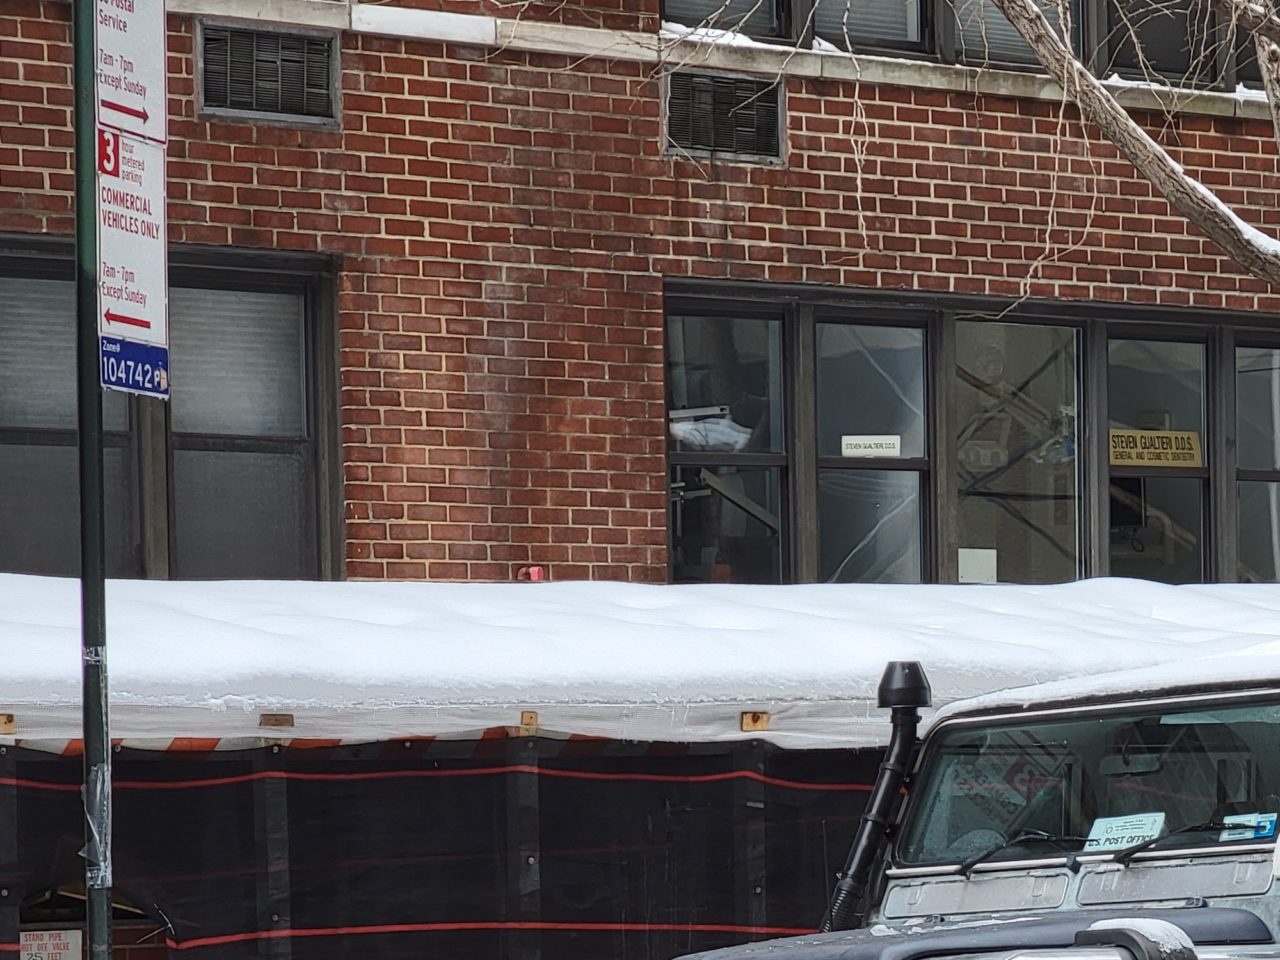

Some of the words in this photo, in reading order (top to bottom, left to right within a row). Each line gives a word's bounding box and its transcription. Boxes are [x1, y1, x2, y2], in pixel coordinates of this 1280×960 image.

[99, 9, 127, 33] Service
[99, 48, 113, 67] 7am
[119, 54, 133, 73] 7pm
[99, 69, 122, 91] Except
[124, 76, 147, 101] Sunday
[103, 131, 115, 171] 3
[122, 156, 145, 171] metered
[122, 169, 142, 187] parking
[101, 186, 152, 216] COMMERCIAL
[101, 208, 139, 234] VEHICLES
[140, 220, 160, 240] ONLY
[102, 261, 116, 278] 7am
[121, 266, 135, 284] 7pm
[102, 281, 123, 302] Except
[124, 286, 147, 308] Sunday
[103, 356, 153, 389] 104742
[1112, 434, 1138, 450] STEVEN
[1113, 450, 1134, 460] GENERAL
[1136, 451, 1145, 460] AND
[1146, 451, 1170, 461] COSMETIC
[1103, 836, 1125, 846] POST
[24, 932, 44, 942] STAND
[52, 942, 70, 951] VALVE
[48, 952, 62, 960] FEET
